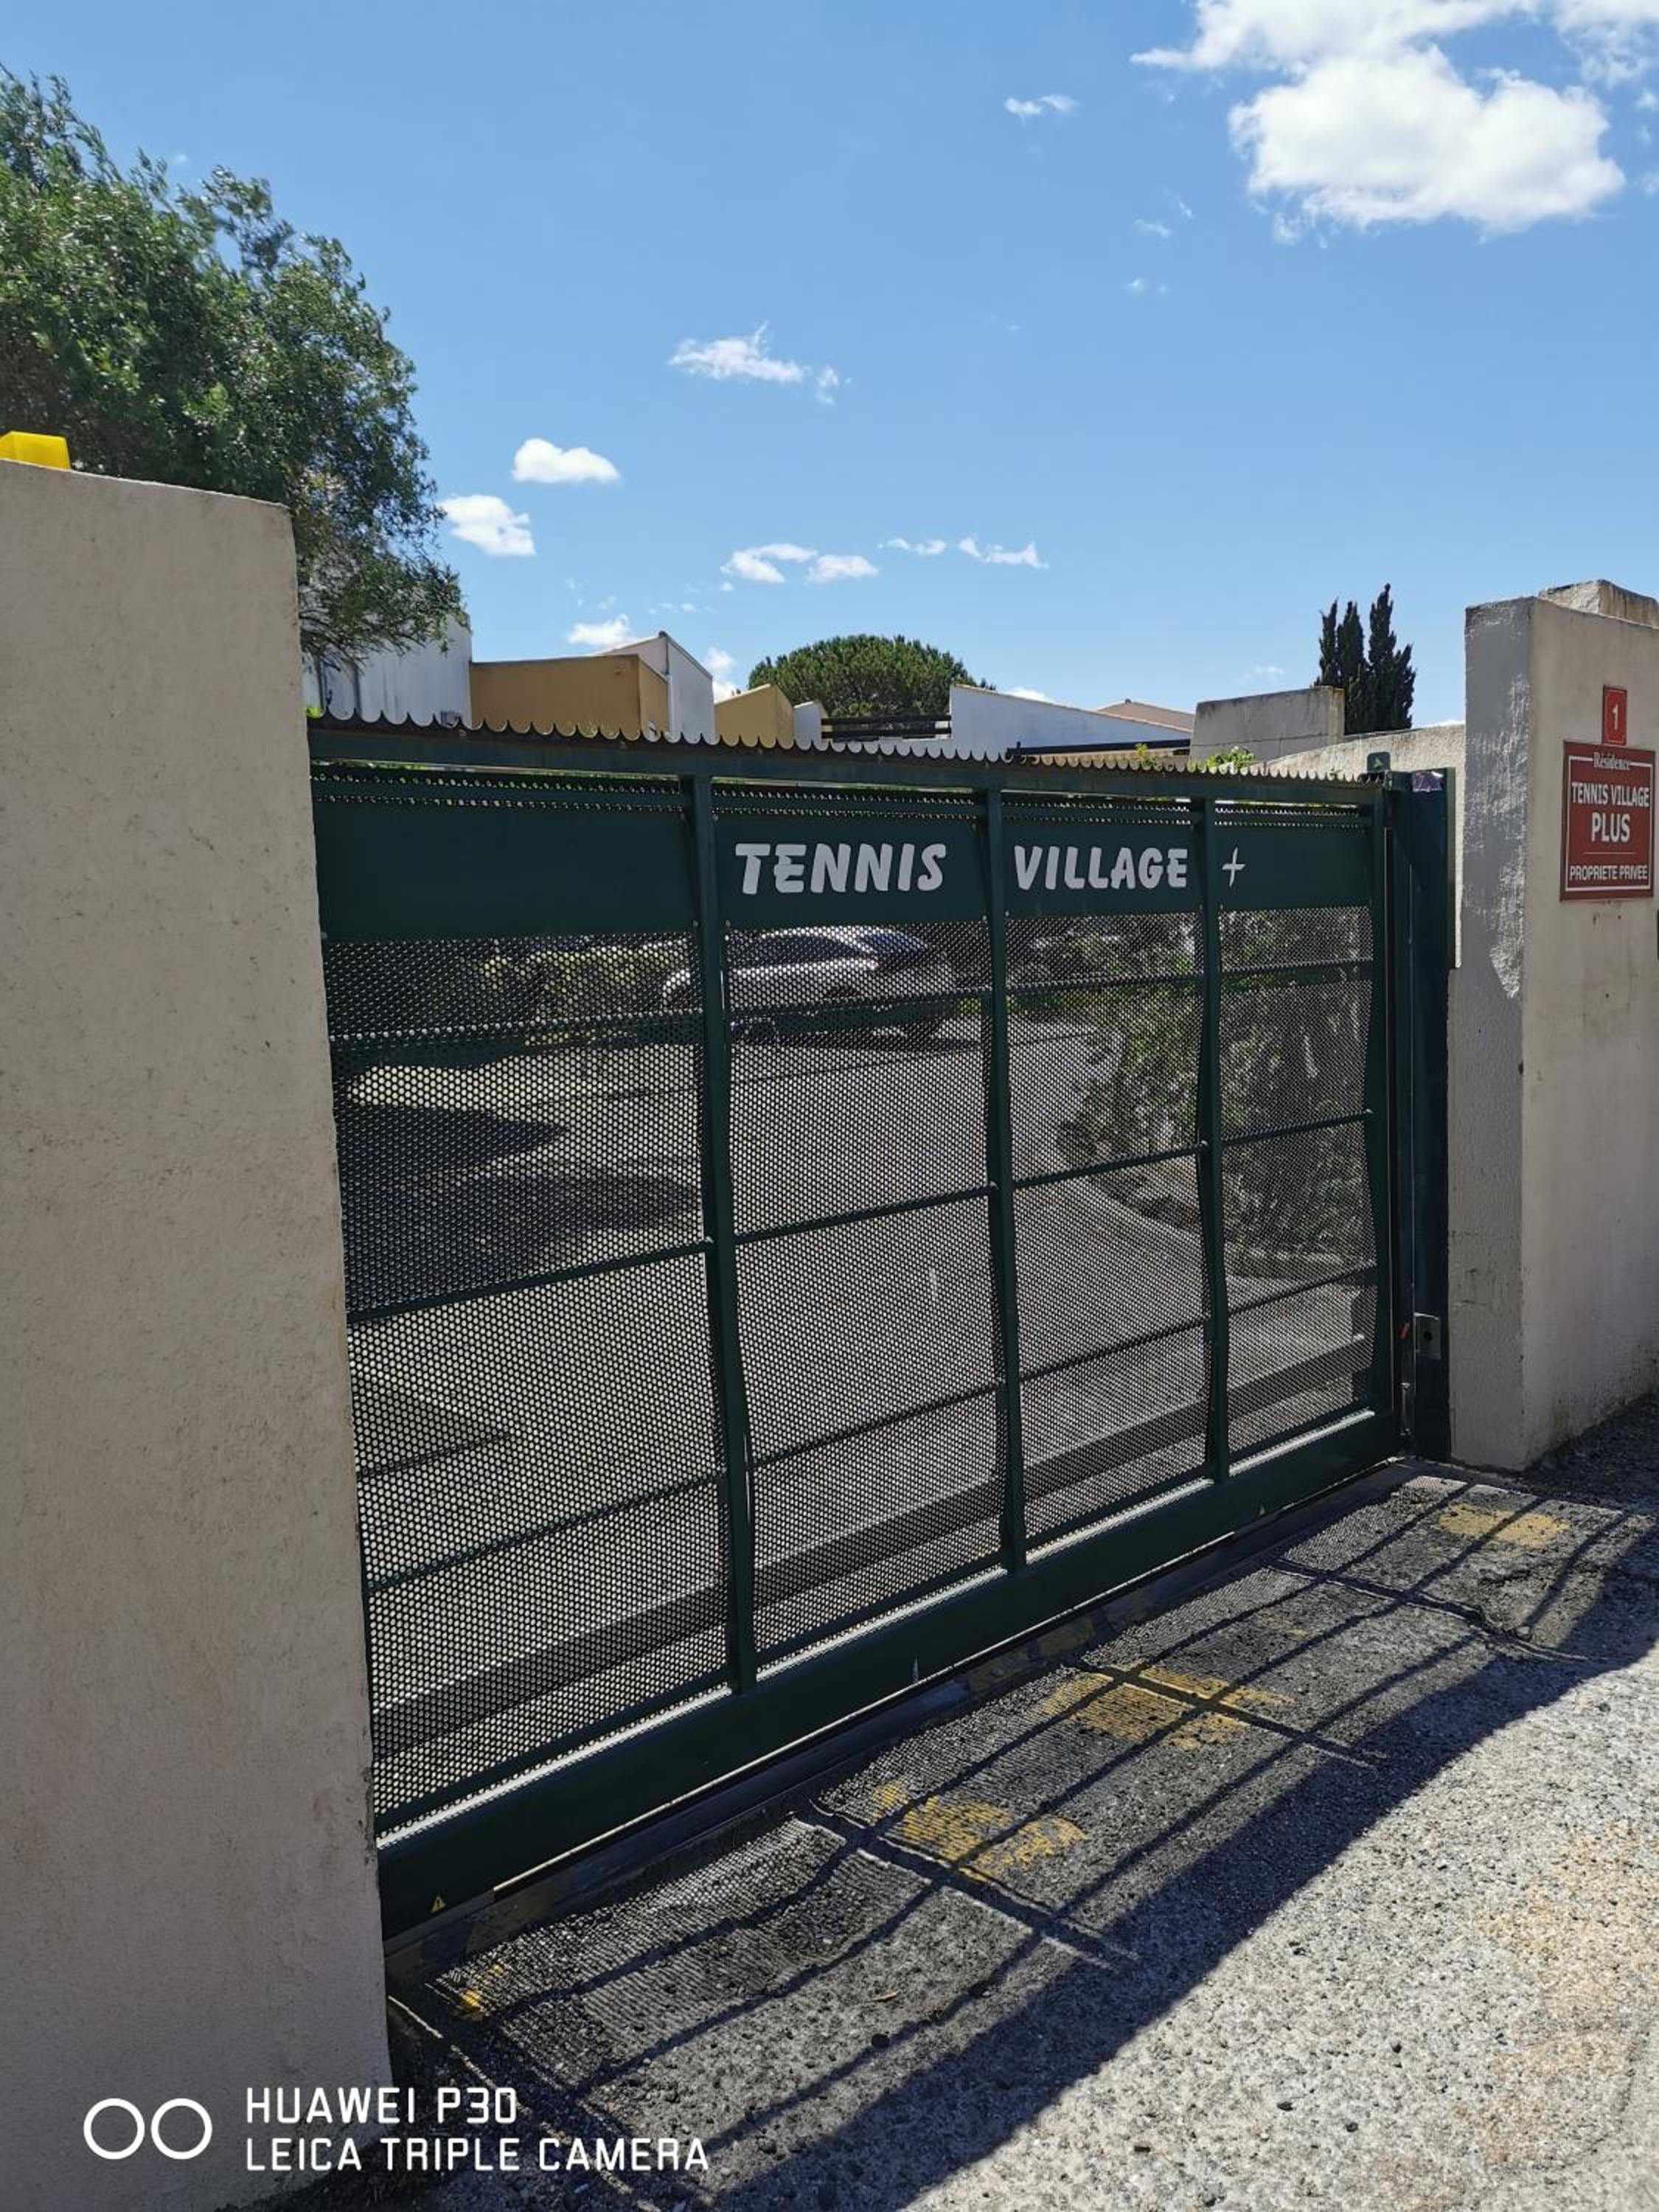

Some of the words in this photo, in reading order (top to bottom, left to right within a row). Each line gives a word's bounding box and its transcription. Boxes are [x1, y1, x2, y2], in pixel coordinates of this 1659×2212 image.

[1612, 703, 1620, 731] 1
[1571, 782, 1609, 805] TENNIS
[1610, 784, 1650, 807] VILLAGE
[1591, 812, 1630, 843] PLUS
[735, 843, 946, 894] TENNIS
[1014, 845, 1188, 890] VILLAGE
[1569, 865, 1618, 881] PROPRIETE
[1619, 865, 1648, 880] PRIVEE
